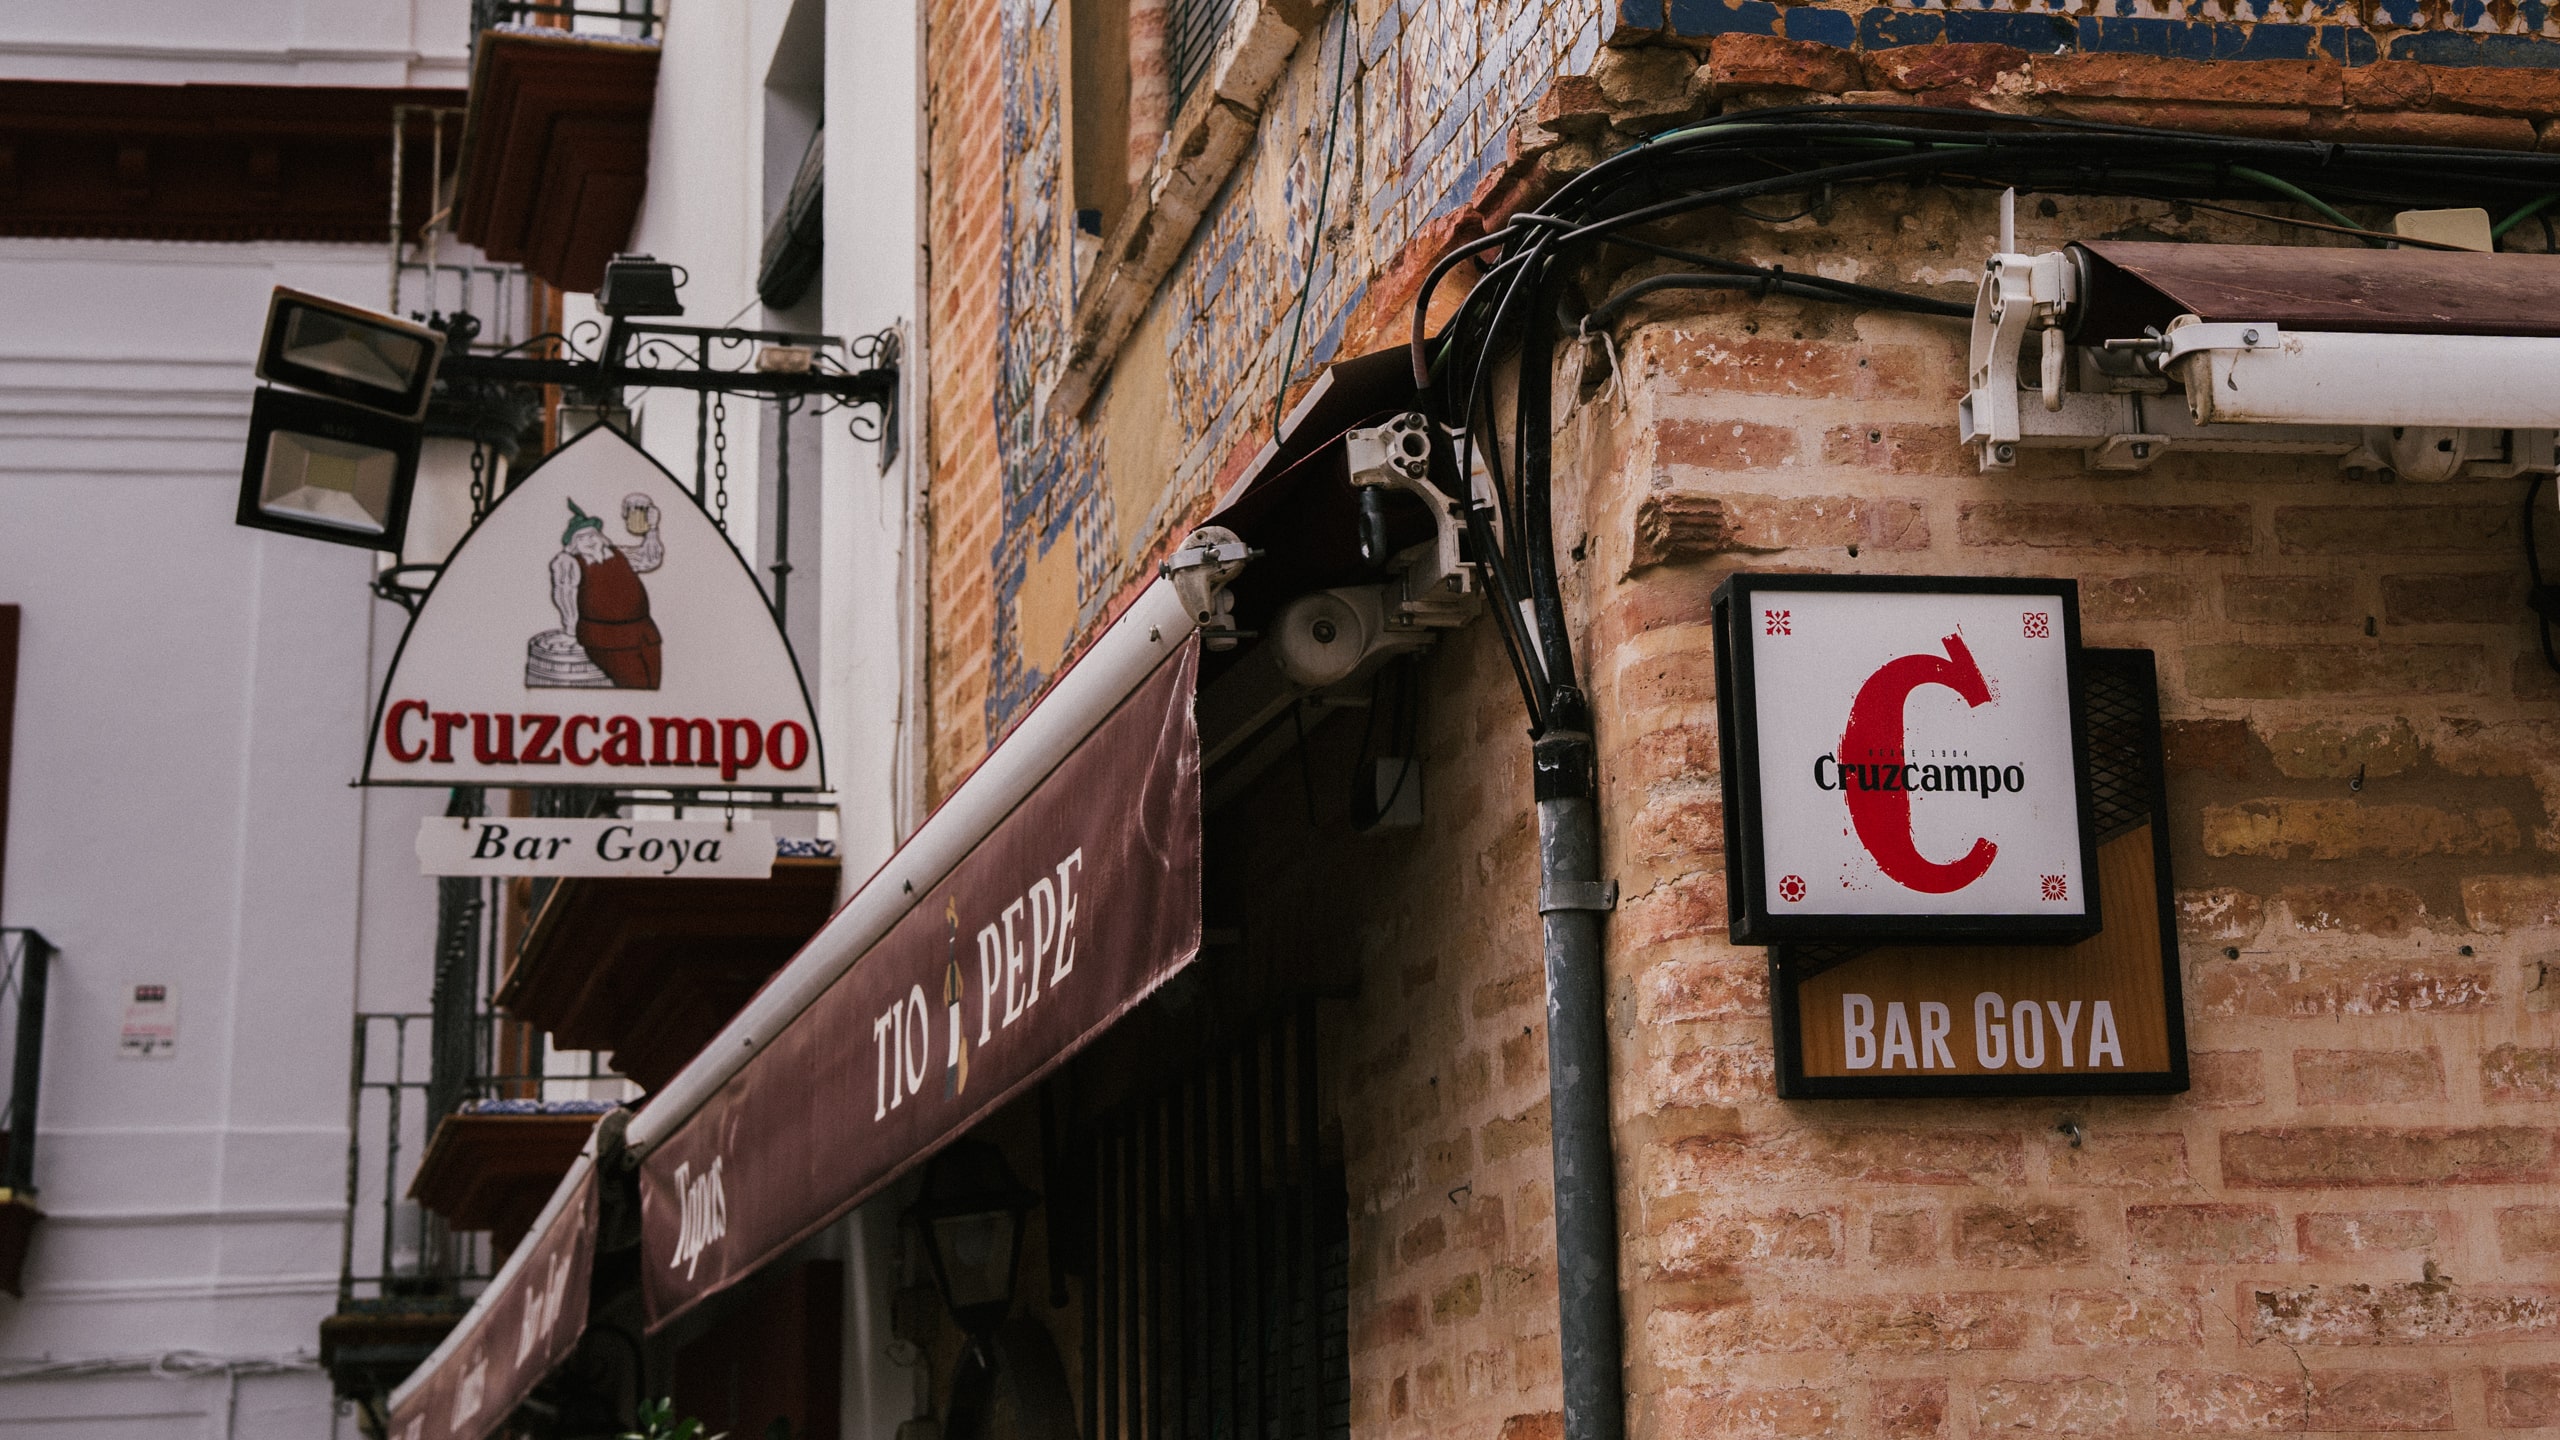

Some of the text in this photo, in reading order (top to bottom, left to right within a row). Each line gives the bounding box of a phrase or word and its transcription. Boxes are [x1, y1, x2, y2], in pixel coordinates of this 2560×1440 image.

[384, 699, 809, 781] Cruzcampo
[1814, 752, 2025, 799] Cruzcampo
[470, 823, 723, 874] Bar Goya
[873, 846, 1082, 1123] TIO PEPE
[1842, 991, 2125, 1070] BAR GOYA
